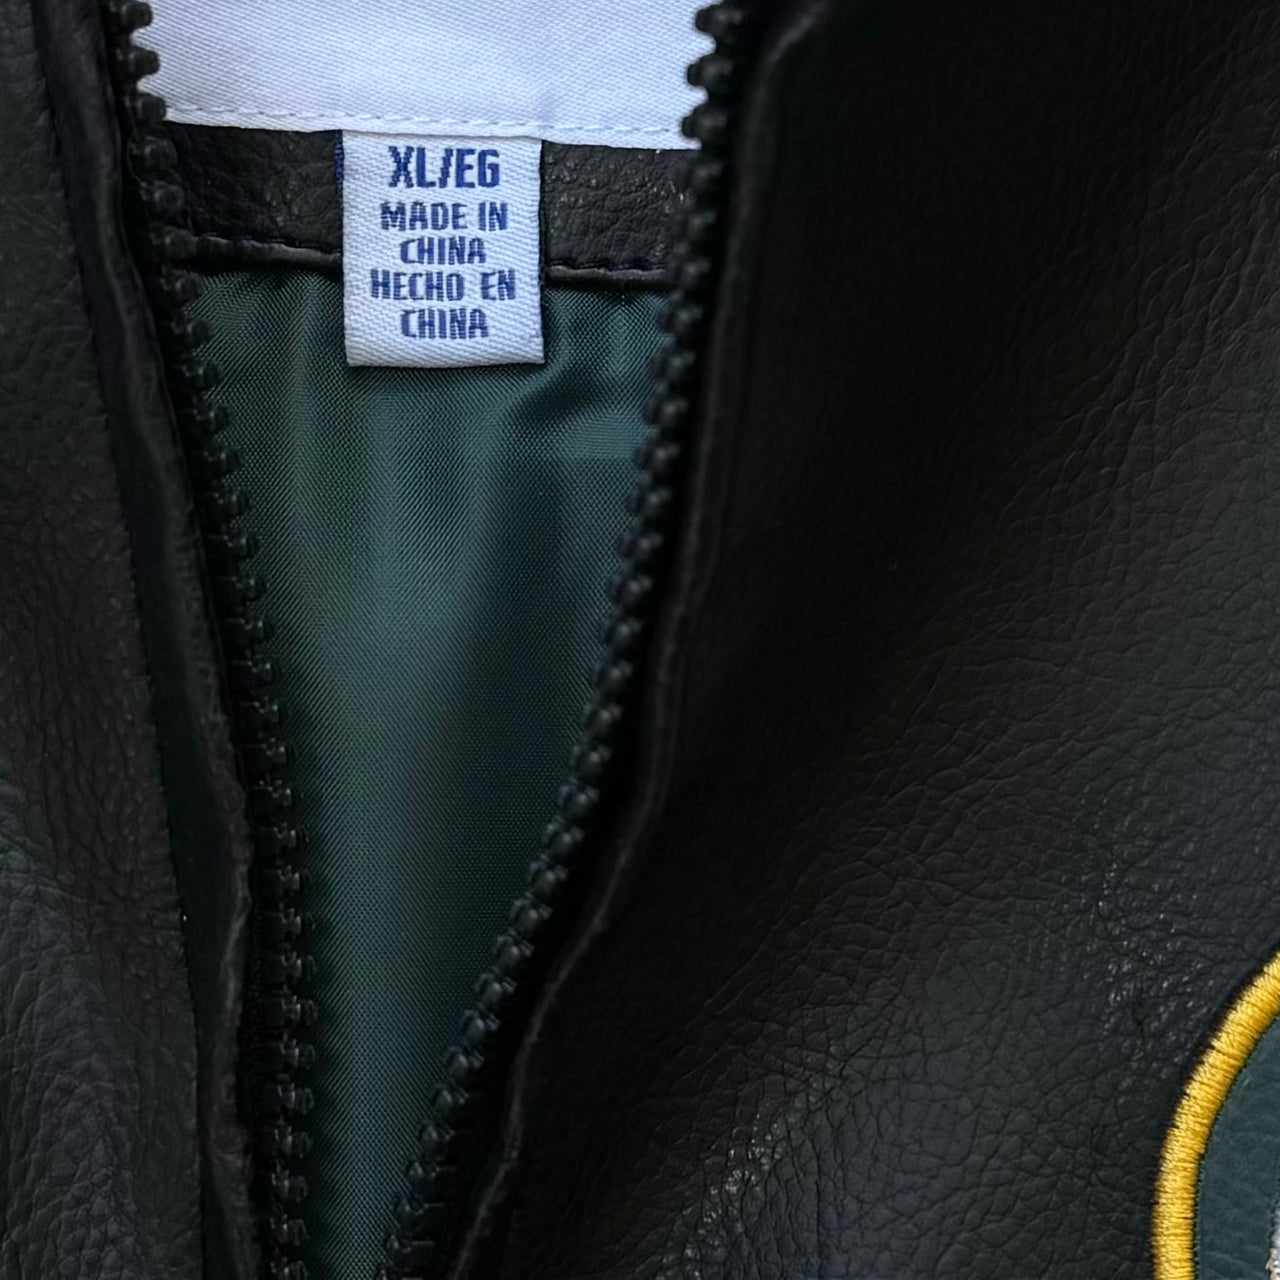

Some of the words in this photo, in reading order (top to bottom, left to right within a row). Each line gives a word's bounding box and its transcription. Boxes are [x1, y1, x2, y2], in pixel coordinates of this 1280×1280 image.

[387, 145, 501, 189] XL/EG
[380, 201, 469, 232] MADE
[477, 201, 509, 232] IN
[398, 235, 487, 266] CHINA
[369, 268, 466, 302] HECHO
[479, 269, 517, 302] EN
[400, 307, 490, 340] CHINA
